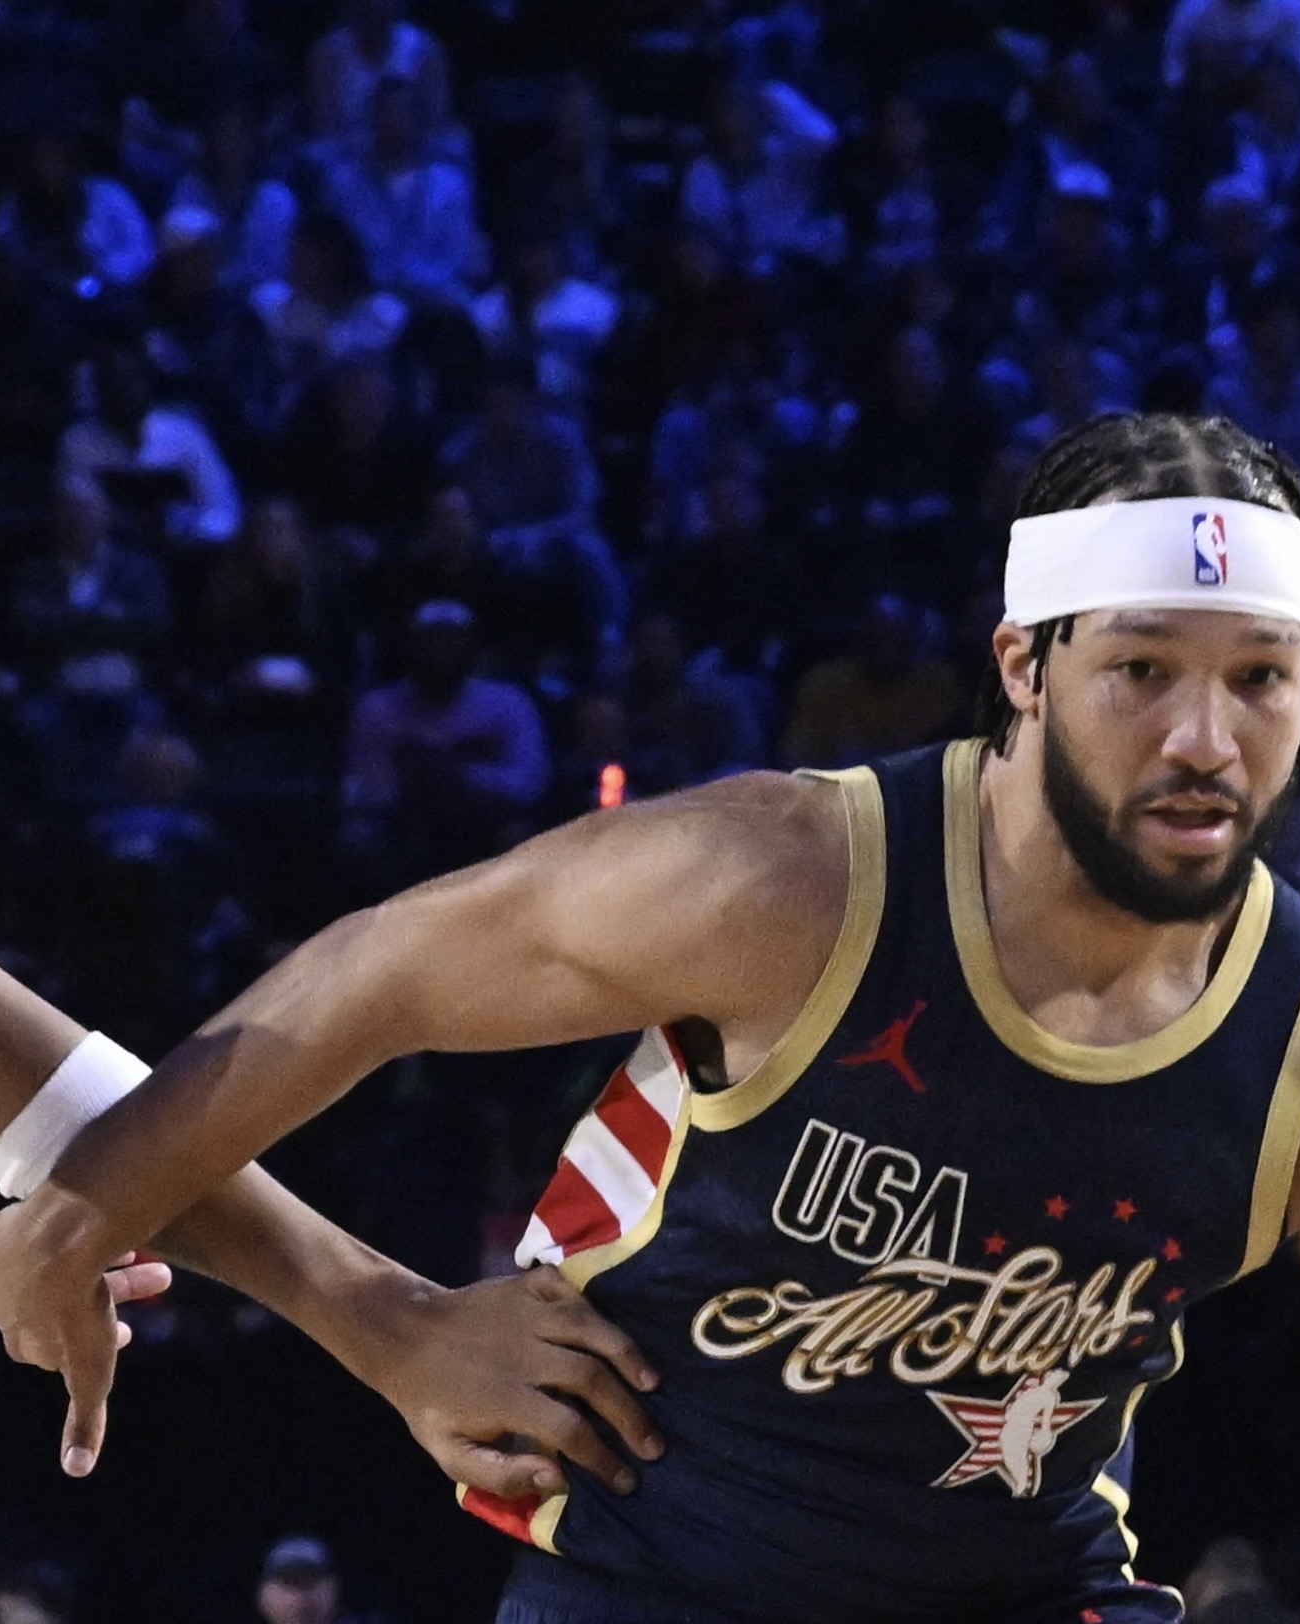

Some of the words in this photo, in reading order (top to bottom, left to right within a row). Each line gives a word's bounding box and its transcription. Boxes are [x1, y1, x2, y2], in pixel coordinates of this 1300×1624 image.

[771, 1118, 968, 1287] USA
[690, 1280, 938, 1395] All
[858, 1245, 1157, 1385] Stars
